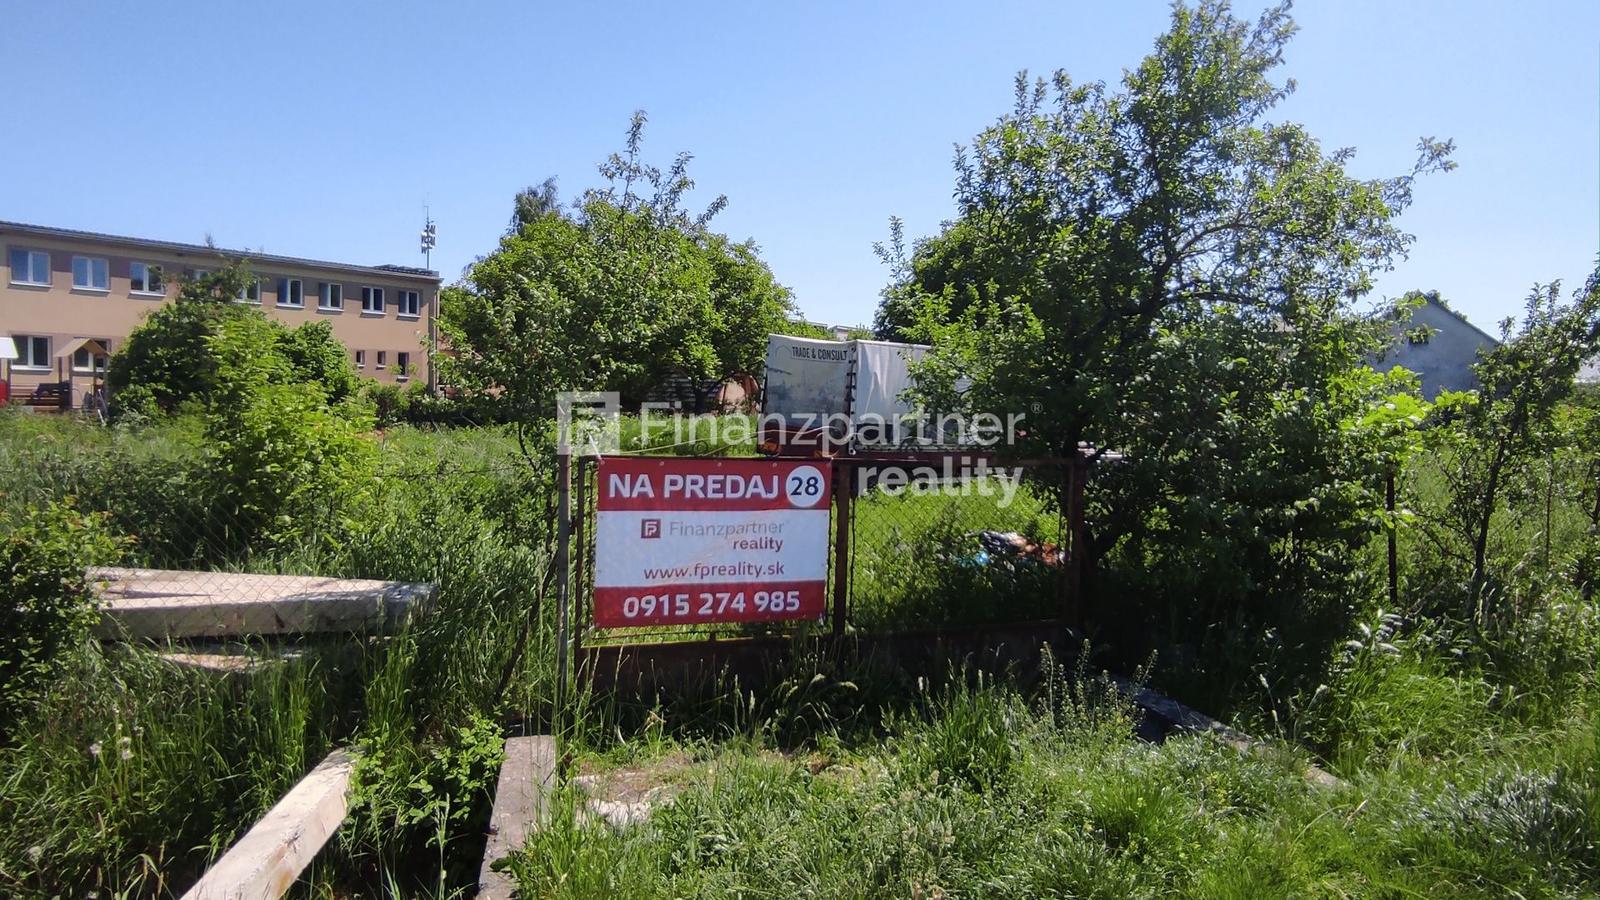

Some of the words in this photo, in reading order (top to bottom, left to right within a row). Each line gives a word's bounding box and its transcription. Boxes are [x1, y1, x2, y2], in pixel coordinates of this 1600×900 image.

[792, 346, 810, 359] TRADE
[811, 349, 816, 359] &
[818, 349, 848, 361] CONSULT
[608, 473, 654, 498] NA
[664, 474, 779, 500] PREDAJ
[790, 476, 819, 497] 28
[669, 520, 784, 539] Finanzpartner
[732, 537, 783, 553] reality
[644, 561, 785, 581] www.fpreality.sk
[623, 593, 690, 619] 0915
[699, 592, 746, 615] 274
[753, 590, 800, 613] 985
